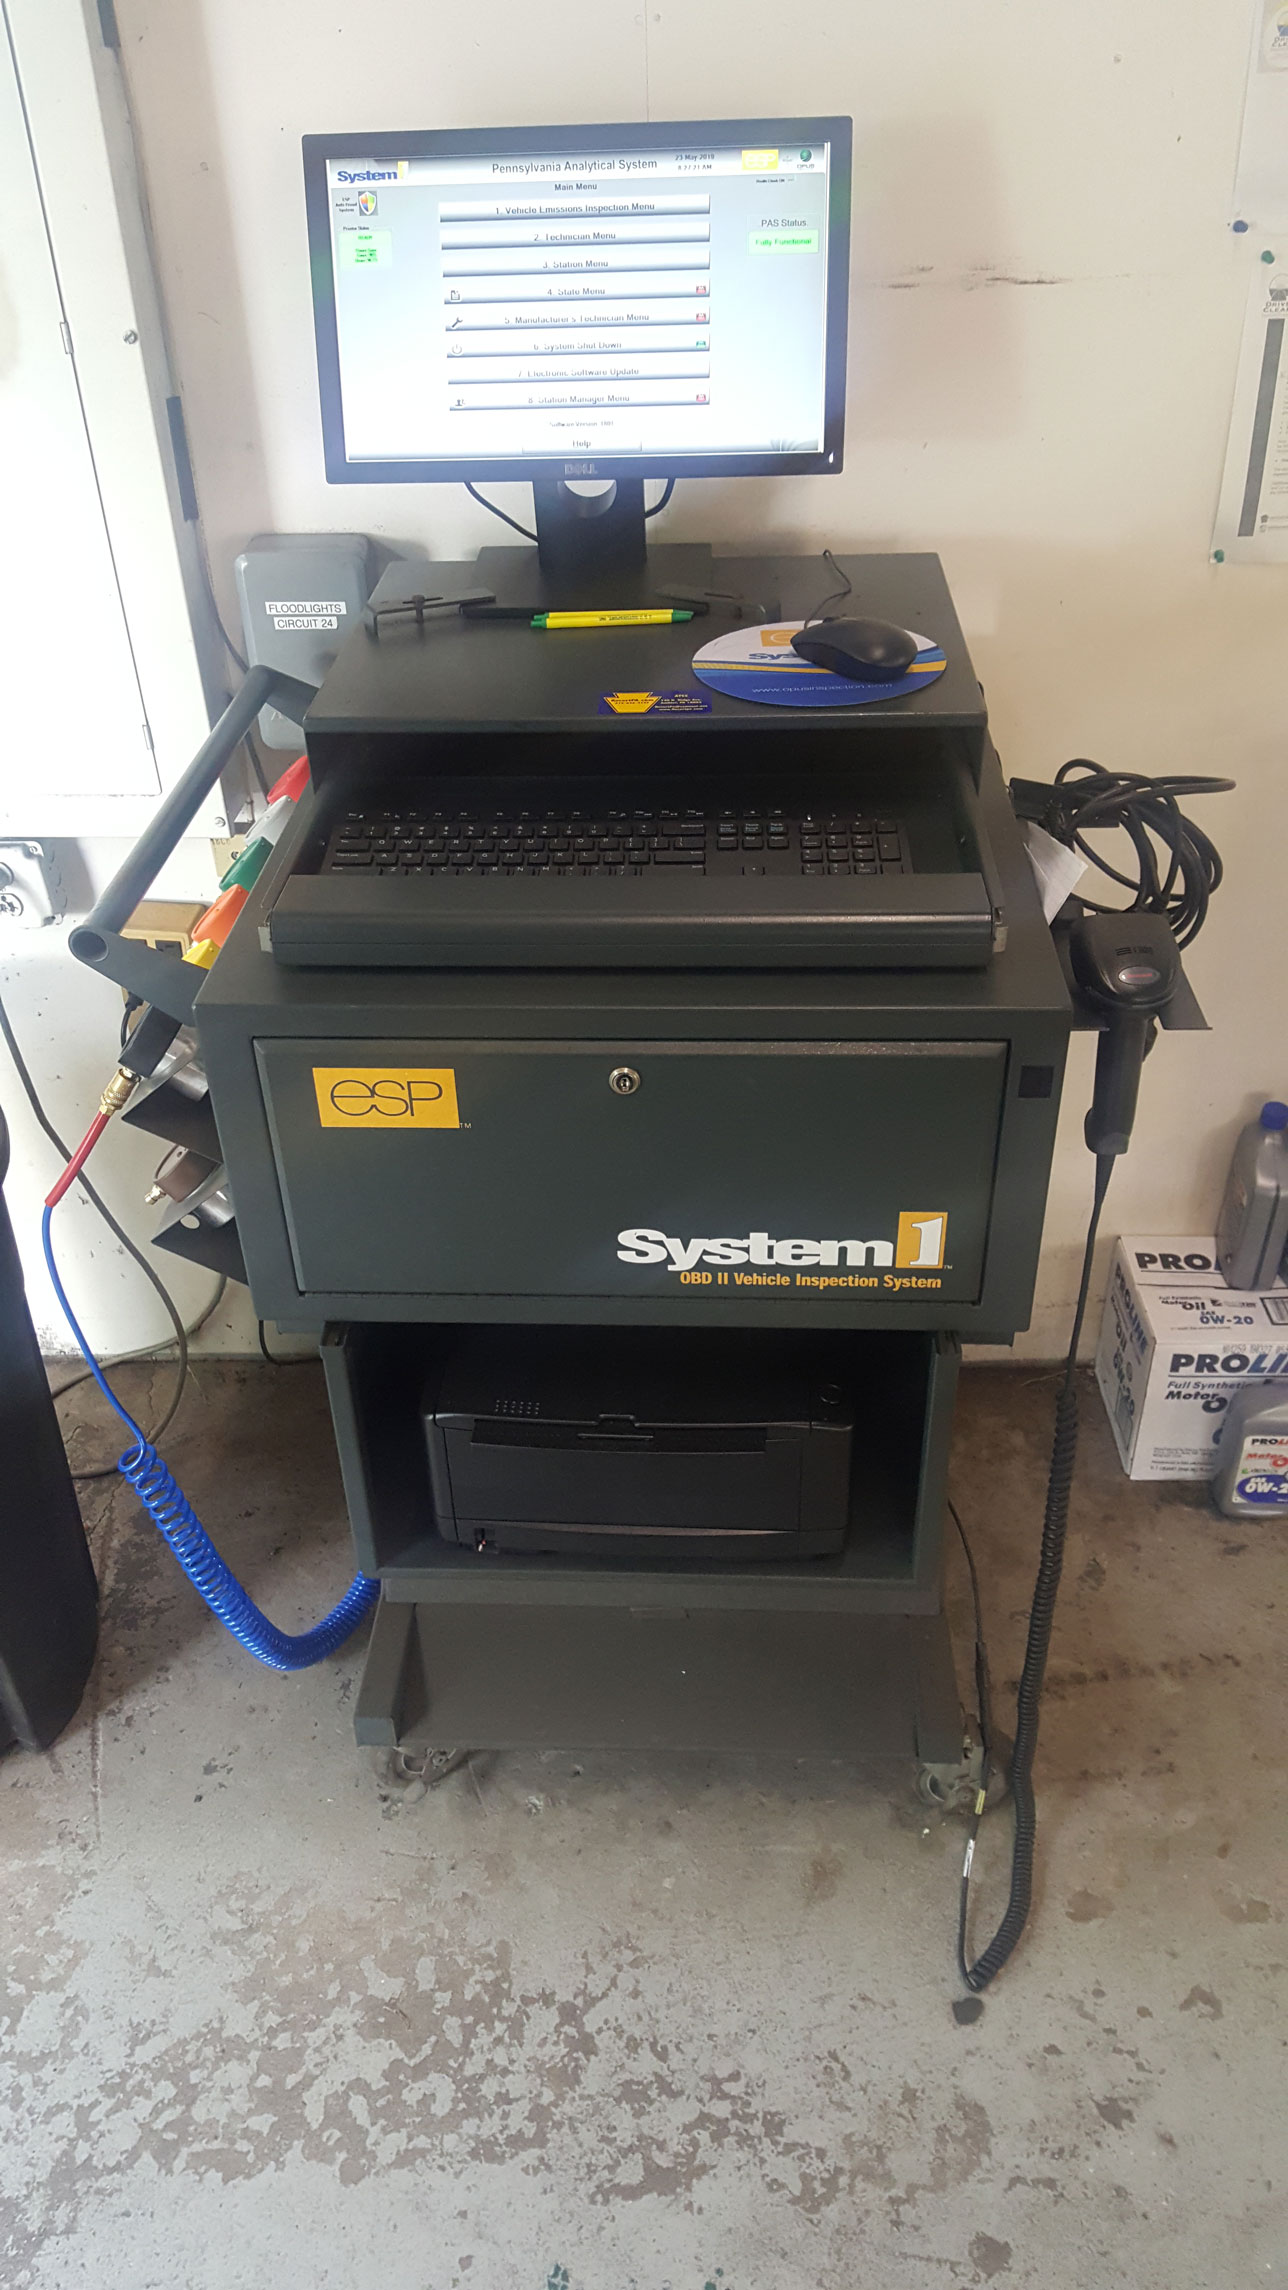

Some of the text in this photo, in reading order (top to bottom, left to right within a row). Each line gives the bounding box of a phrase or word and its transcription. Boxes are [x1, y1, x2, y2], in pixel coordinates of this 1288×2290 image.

[492, 158, 658, 175] Pennsylvania Analytical System
[336, 170, 398, 184] System
[505, 206, 537, 214] Vehicle
[539, 205, 582, 214] Emissions
[586, 204, 630, 214] Inspection
[632, 202, 655, 210] Menu
[761, 218, 807, 227] PAS Status
[546, 232, 591, 240] Technician
[593, 232, 616, 240] Menu
[553, 260, 583, 268] Station
[586, 260, 608, 268] Menu
[582, 287, 606, 295] Menu
[544, 342, 574, 352] System
[577, 342, 596, 350] Shut
[598, 341, 622, 349] Down
[528, 368, 568, 378] Electronic
[571, 368, 608, 376] Software
[610, 367, 639, 378] Update
[538, 395, 568, 404] Station
[570, 394, 605, 405] Manager
[608, 394, 630, 402] Menu
[572, 440, 592, 448] Help
[564, 464, 598, 475] DELL
[268, 604, 342, 614] FLOODLIGHTS
[277, 618, 333, 628] CIRCUIT 24
[748, 652, 801, 660] Sys
[330, 1079, 443, 1116] esp
[617, 1228, 894, 1272] System
[1134, 1252, 1222, 1270] PRO
[680, 1272, 942, 1291] OBD II Vehicle Inspection System
[1182, 1302, 1206, 1310] Oil
[1200, 1316, 1254, 1324] 0W-20
[1164, 1390, 1220, 1400] Motor
